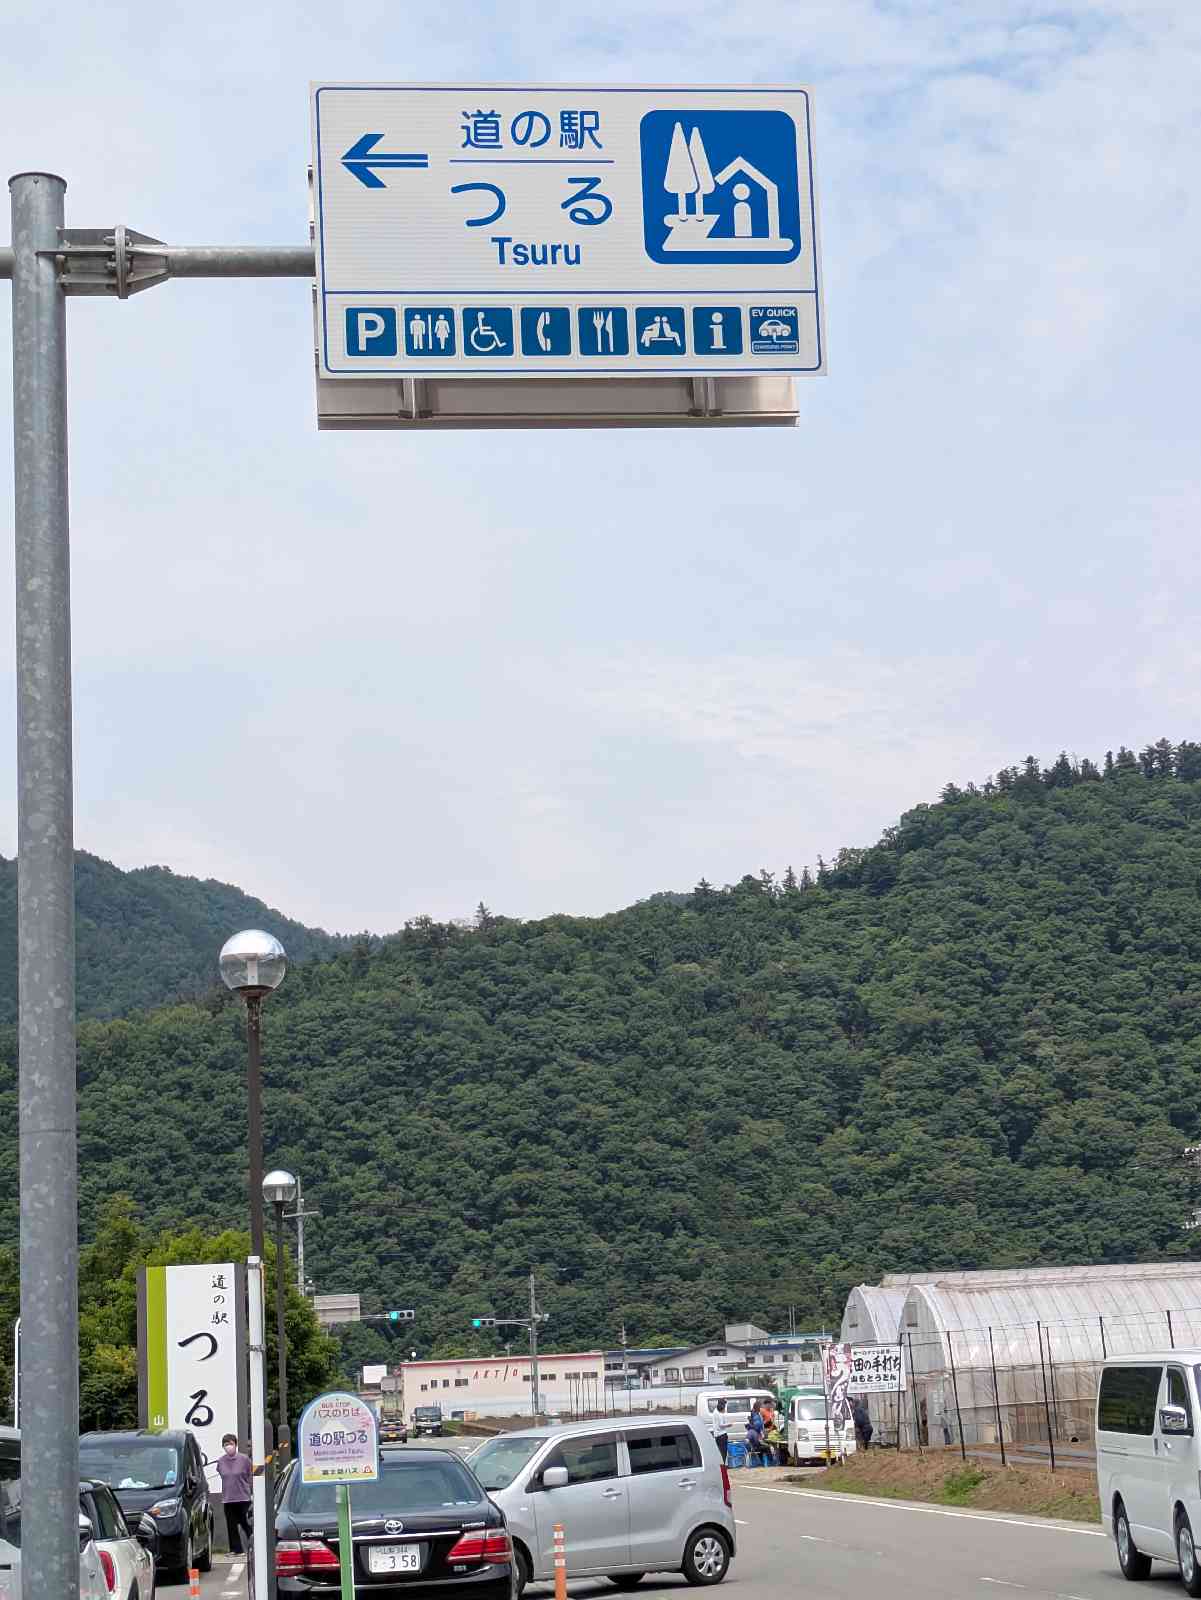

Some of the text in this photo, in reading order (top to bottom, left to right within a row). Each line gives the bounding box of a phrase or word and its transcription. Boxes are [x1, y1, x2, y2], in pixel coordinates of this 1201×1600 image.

[461, 109, 603, 149] 道の駅
[451, 176, 613, 227] つる
[491, 236, 581, 266] Tsuru
[357, 312, 386, 352] P
[751, 308, 796, 317] EV QUICK
[211, 1275, 229, 1325] 道の駅
[177, 1331, 218, 1428] つる
[310, 1429, 368, 1447] 道の駅つる
